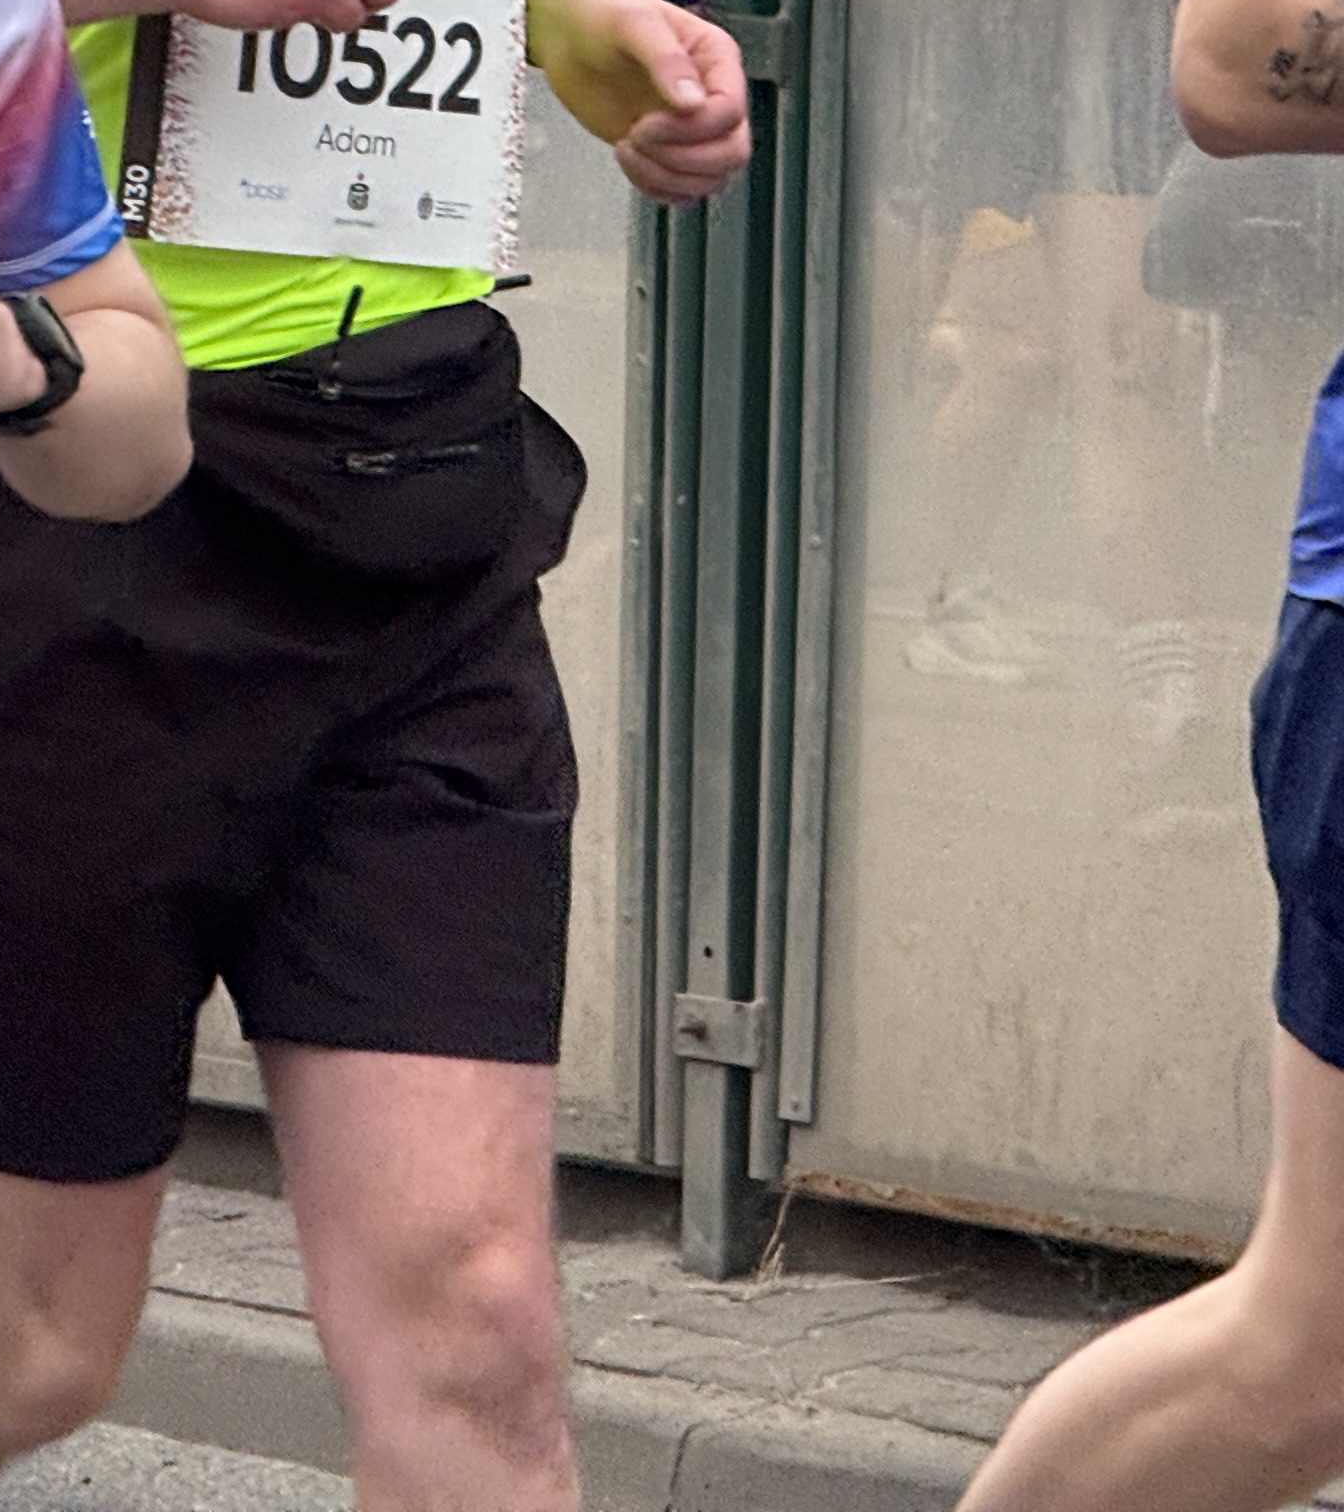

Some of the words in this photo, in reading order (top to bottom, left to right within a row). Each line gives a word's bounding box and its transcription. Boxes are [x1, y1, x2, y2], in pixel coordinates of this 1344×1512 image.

[237, 15, 484, 116] 10522
[315, 123, 397, 158] Adam
[122, 164, 151, 223] M30
